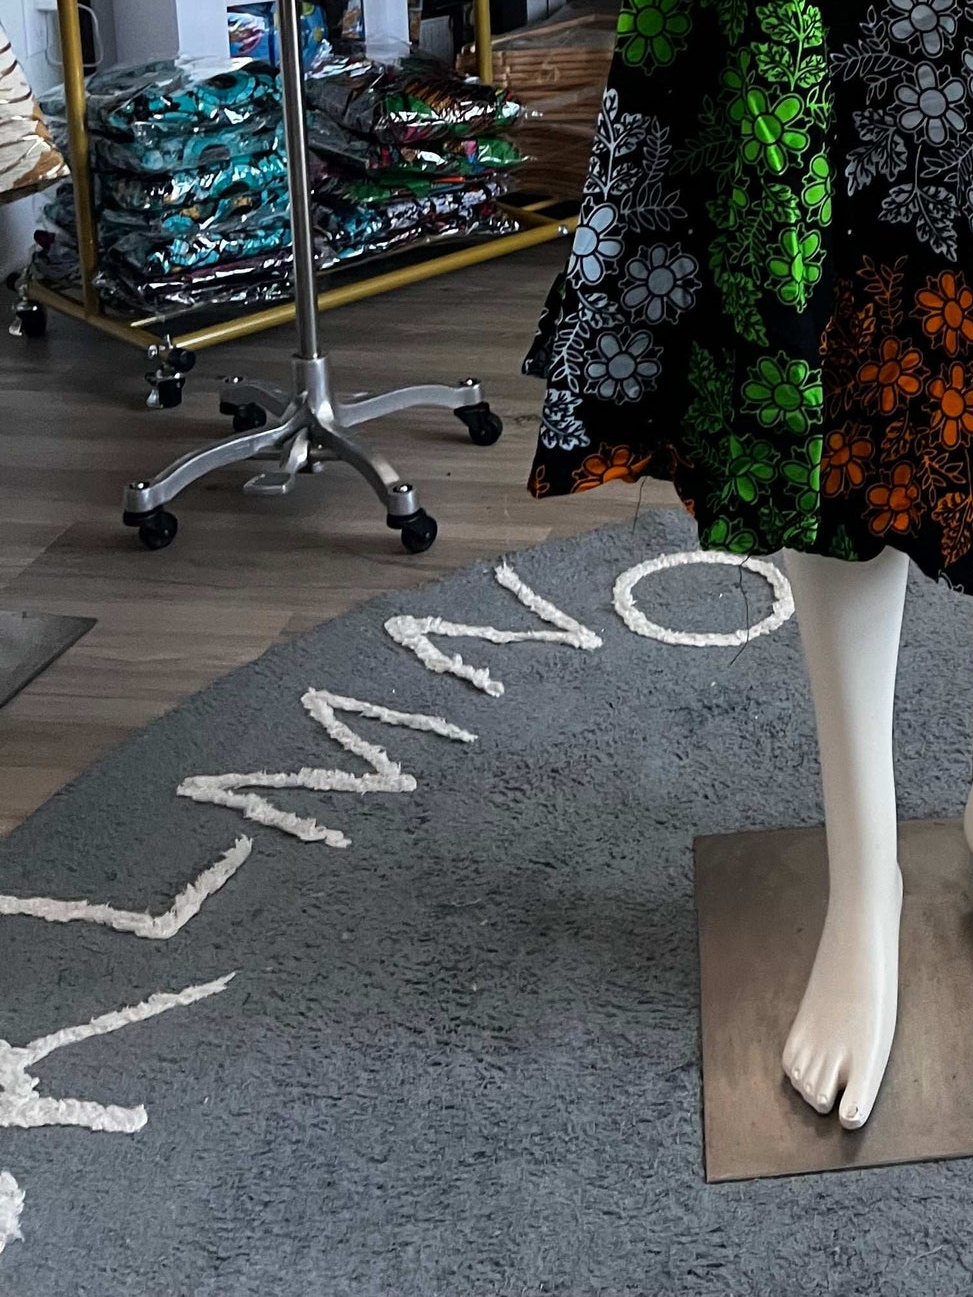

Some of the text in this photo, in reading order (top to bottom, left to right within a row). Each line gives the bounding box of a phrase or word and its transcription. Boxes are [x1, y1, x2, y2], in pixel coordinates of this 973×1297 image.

[177, 687, 478, 848] M
[384, 561, 604, 698] N
[612, 550, 795, 647] O
